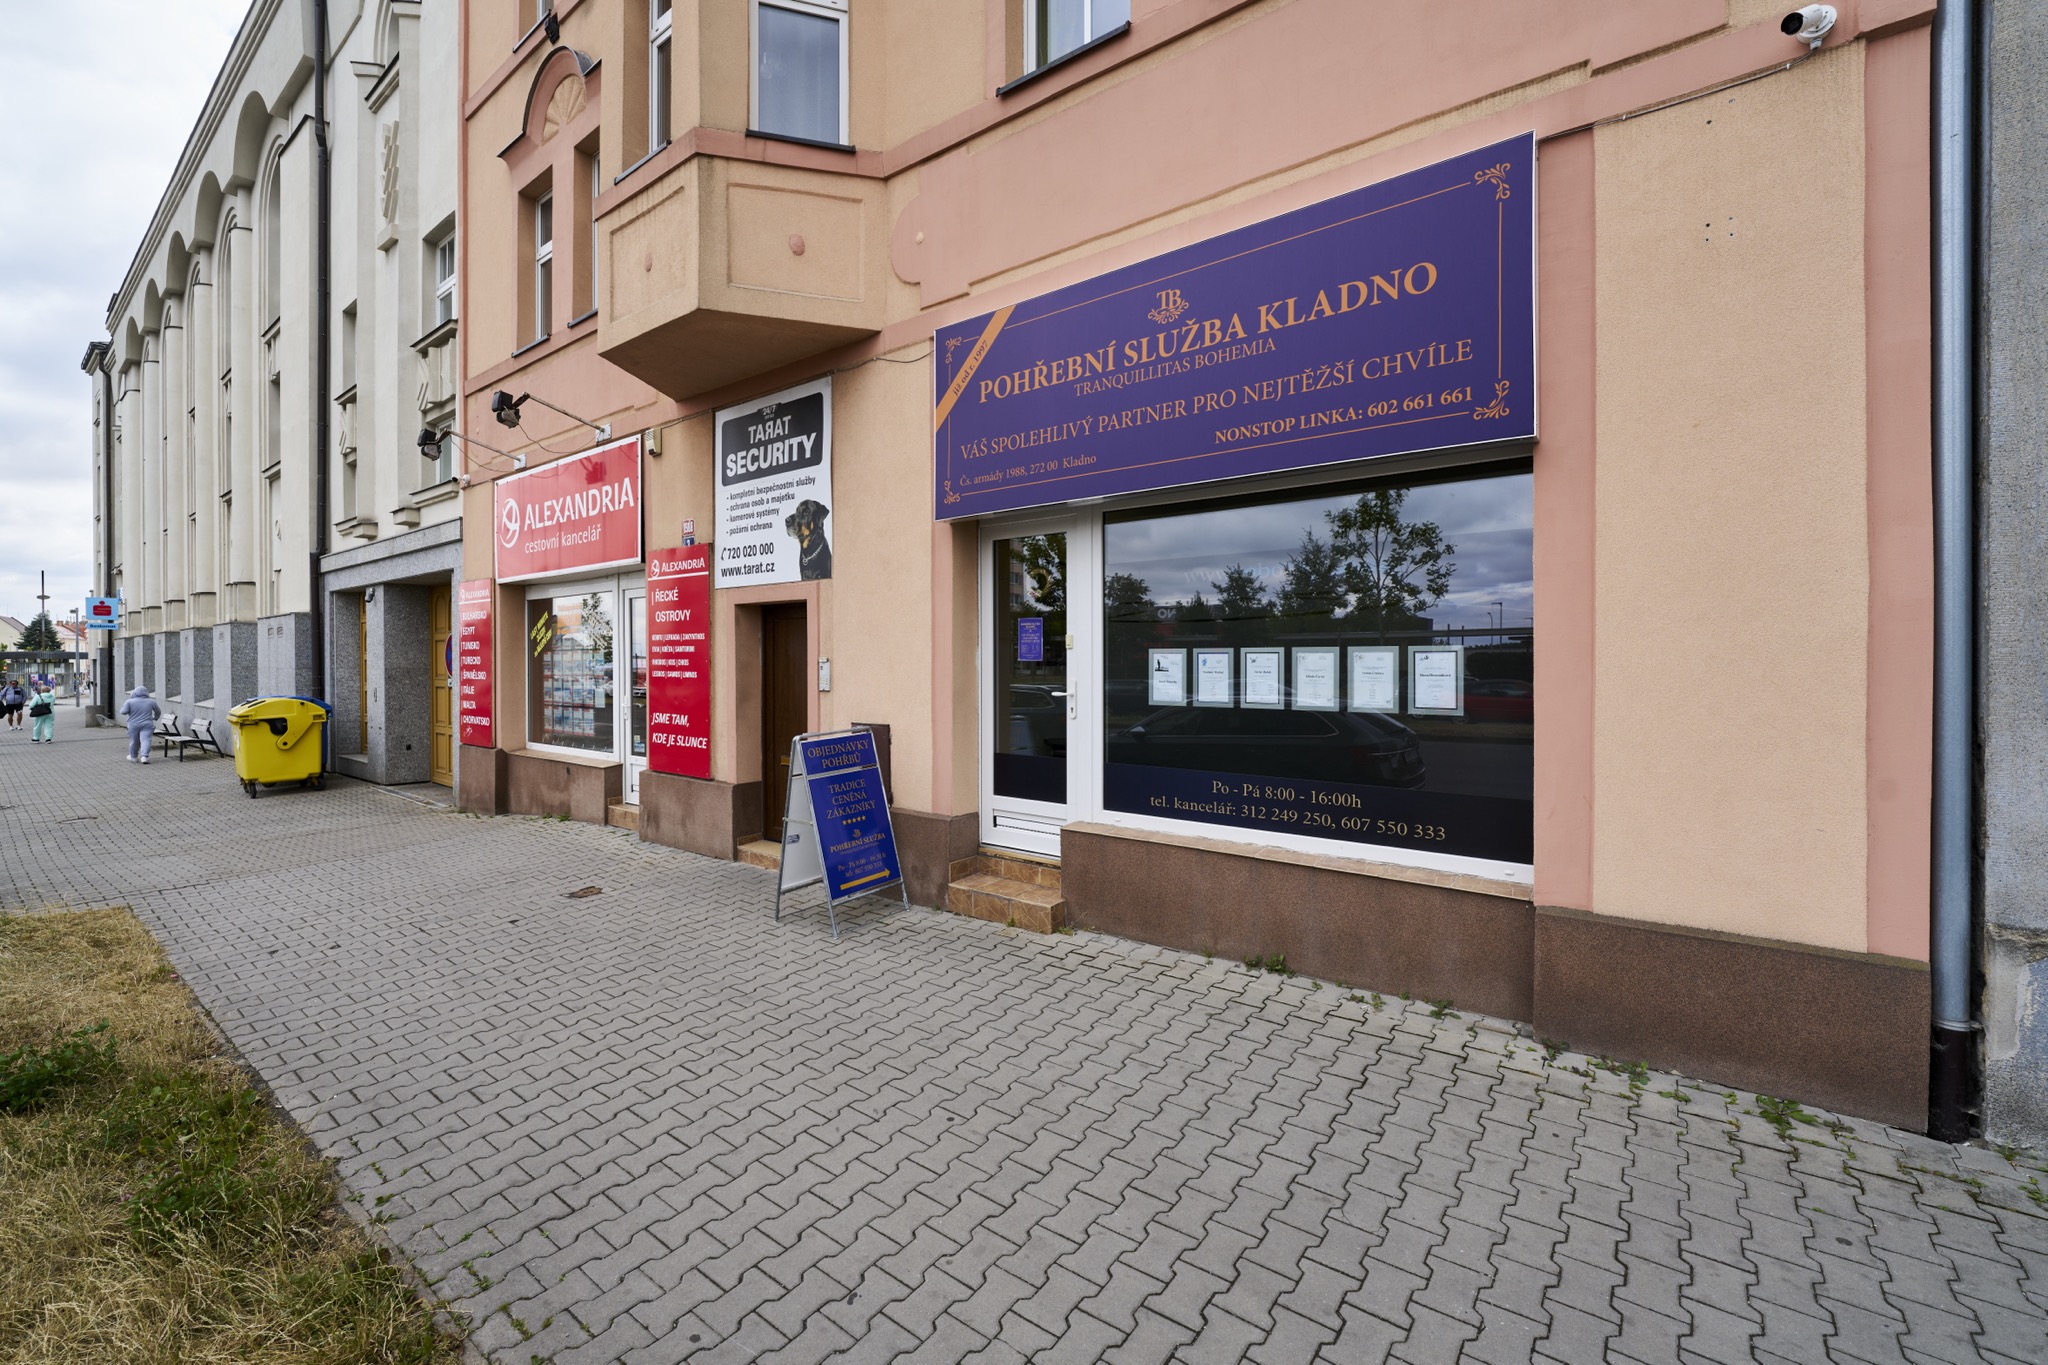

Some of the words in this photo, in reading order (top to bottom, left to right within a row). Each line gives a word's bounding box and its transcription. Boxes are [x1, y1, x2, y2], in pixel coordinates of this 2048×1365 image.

[1156, 289, 1182, 310] TB
[979, 340, 1116, 403] POHŘEBNÍ
[1123, 313, 1247, 367] SLUŽBA
[1257, 262, 1438, 334] KLADNO
[962, 370, 970, 383] od
[974, 340, 988, 363] 1997
[1074, 358, 1190, 396] TRANQUILLITAS
[1194, 337, 1277, 370] BOHEMIA
[960, 438, 988, 460] VÁŠ
[991, 416, 1094, 454] SPOLEHLIVÝ
[1098, 399, 1187, 432] PARTNER
[1193, 388, 1236, 414] PRO
[1243, 359, 1354, 404] NEJTĚŽŠÍ
[1362, 339, 1473, 380] CHVÍLE
[1214, 418, 1295, 445] NONSTOP
[1300, 406, 1363, 430] LINKA:
[1367, 399, 1398, 418] 602
[1402, 392, 1434, 412] 661
[1440, 386, 1472, 405] 661
[726, 432, 817, 477] SECURITY
[960, 475, 972, 486] Čs.
[974, 470, 1004, 482] armády
[1006, 466, 1028, 478] 1988,
[1030, 462, 1046, 474] 272
[1047, 460, 1058, 470] 00
[1063, 454, 1096, 468] Kladno
[756, 479, 794, 494] bezpečnostní
[796, 476, 816, 487] služby
[524, 477, 634, 531] ALEXANDRIA
[751, 497, 765, 507] osob
[771, 492, 795, 504] majetku
[730, 511, 755, 522] kamerové
[756, 508, 780, 519] systémy
[750, 522, 773, 532] ochrana
[525, 532, 559, 554] cestovní
[562, 524, 602, 547] kancelář
[728, 547, 741, 560] 720
[743, 544, 757, 558] 020
[760, 542, 774, 555] 000
[661, 557, 705, 573] ALEXANDRIA
[721, 562, 775, 577] www.tarat.cz
[655, 586, 678, 602] ŘECKÉ
[463, 610, 487, 620] BULHARSKO
[655, 609, 691, 622] OSTROVY
[463, 626, 475, 635] EGYPT
[463, 669, 486, 680] ŠPANĚLSKO
[463, 715, 490, 726] CHORVATSKO
[651, 712, 671, 725] JSME
[672, 714, 690, 727] TAM,
[652, 733, 667, 744] KDE
[667, 734, 676, 747] JE
[676, 735, 708, 749] SLUNCE
[807, 739, 869, 758] OBJEDNÁVKY
[822, 752, 861, 768] POHŘBŮ
[828, 779, 866, 794] TRADICE
[1212, 780, 1229, 795] Po
[1242, 783, 1260, 798] Pá
[1265, 786, 1295, 801] 8:00
[1311, 790, 1362, 808] 16:00h
[832, 789, 867, 805] CENĚNÁ
[826, 800, 875, 819] ZÁKAZNÍKY
[1150, 796, 1170, 808] tel.
[1174, 797, 1236, 816] kancelář:
[1241, 804, 1266, 819] 312
[1271, 808, 1298, 822] 249
[1303, 812, 1336, 829] 250,
[1341, 816, 1371, 831] 607
[1377, 820, 1408, 836] 550
[1414, 824, 1446, 840] 333
[830, 837, 863, 853] POHŘEBNÍ
[863, 833, 886, 843] SLUŽBA
